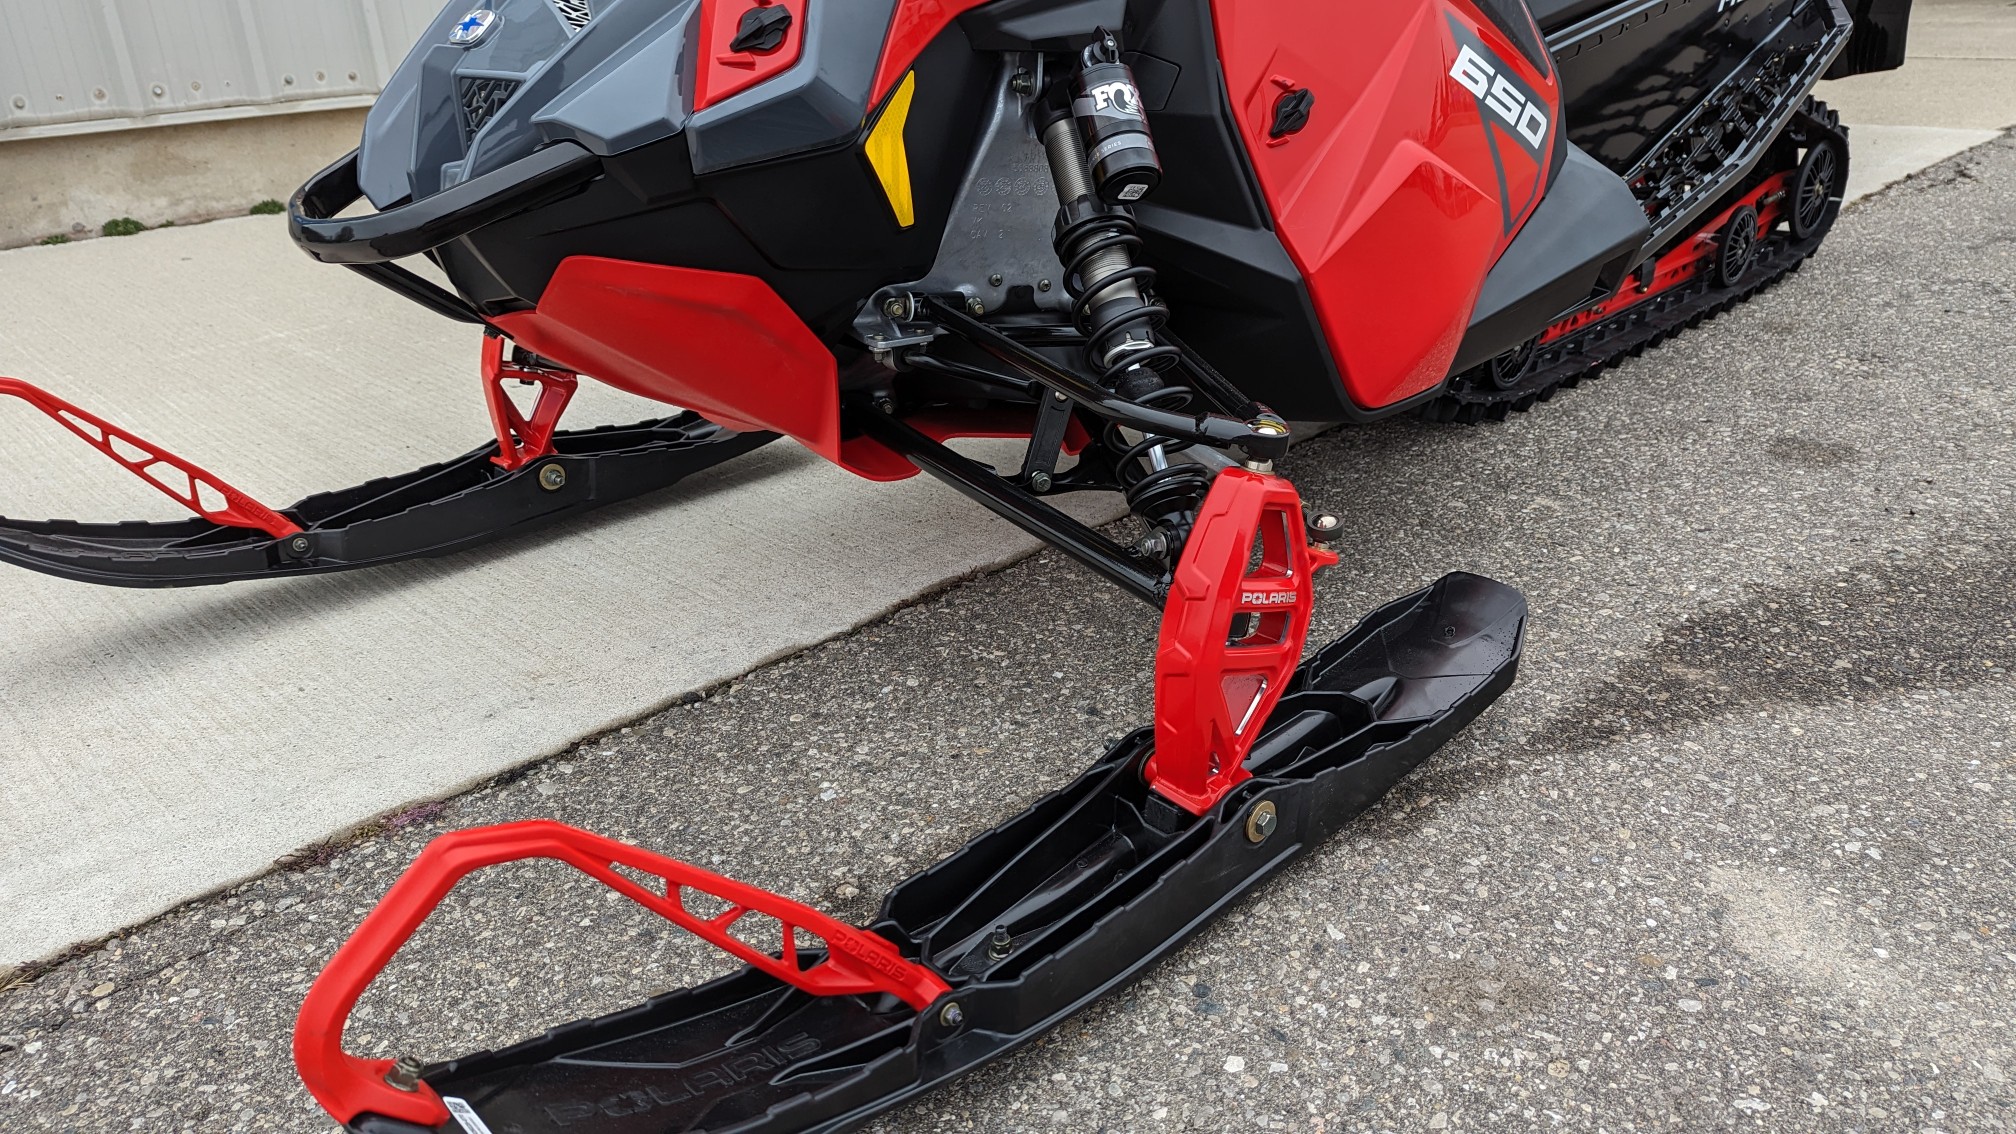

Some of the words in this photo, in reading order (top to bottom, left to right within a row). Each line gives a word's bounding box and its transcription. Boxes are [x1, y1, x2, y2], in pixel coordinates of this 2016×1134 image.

[1091, 81, 1142, 115] FOX
[1449, 44, 1547, 149] 650
[1101, 140, 1122, 154] SERIES
[1242, 592, 1297, 605] POLARIS
[831, 930, 908, 981] POLARIS
[544, 1031, 823, 1126] POLARIS
